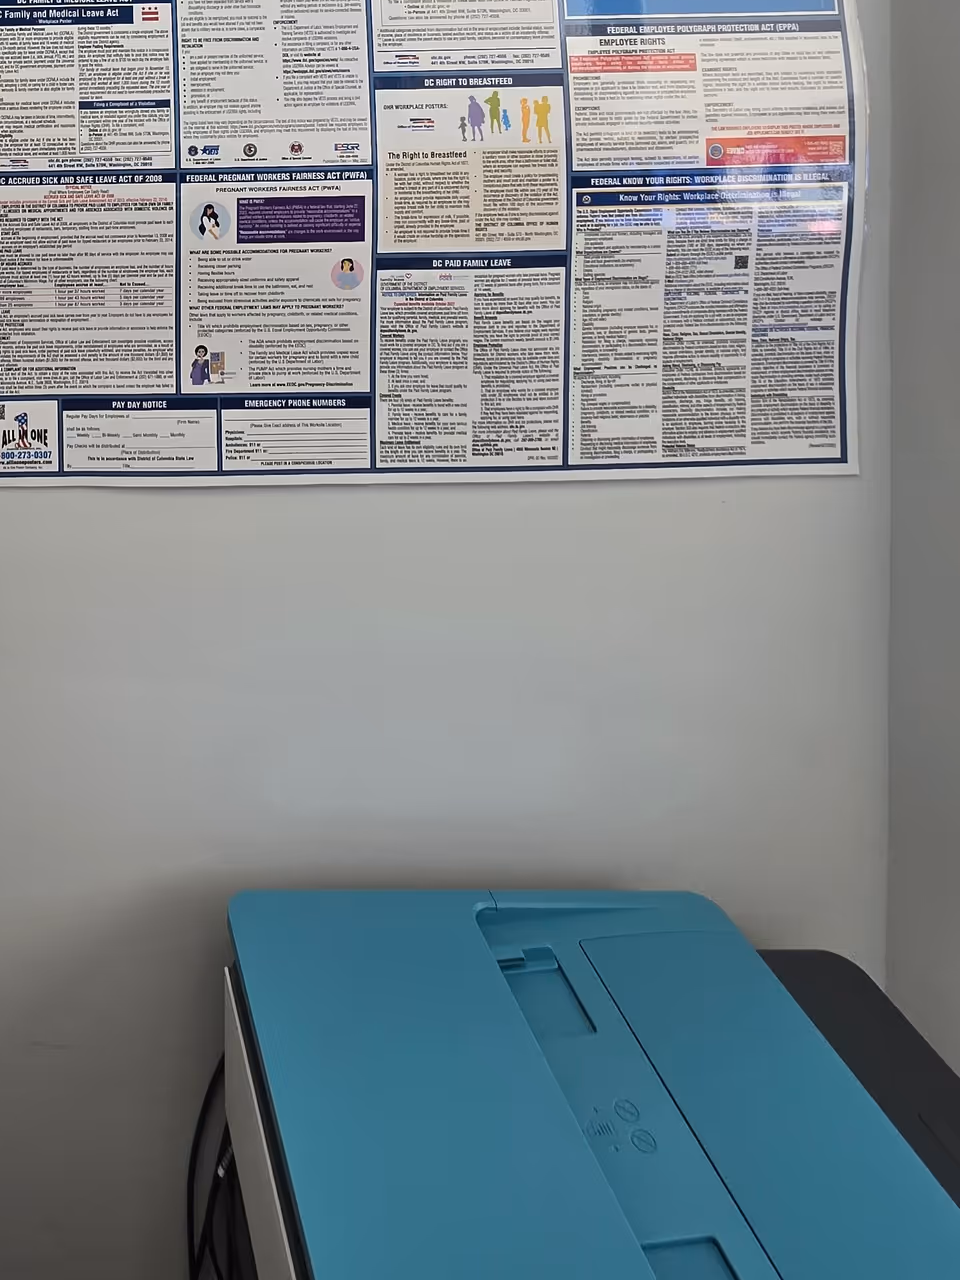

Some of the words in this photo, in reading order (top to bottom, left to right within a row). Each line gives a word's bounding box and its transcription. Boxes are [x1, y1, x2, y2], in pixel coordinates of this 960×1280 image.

[468, 77, 512, 85] BREASTFEED
[342, 171, 367, 181] (PWFA)
[2, 430, 16, 448] ALL
[30, 429, 48, 448] ONE
